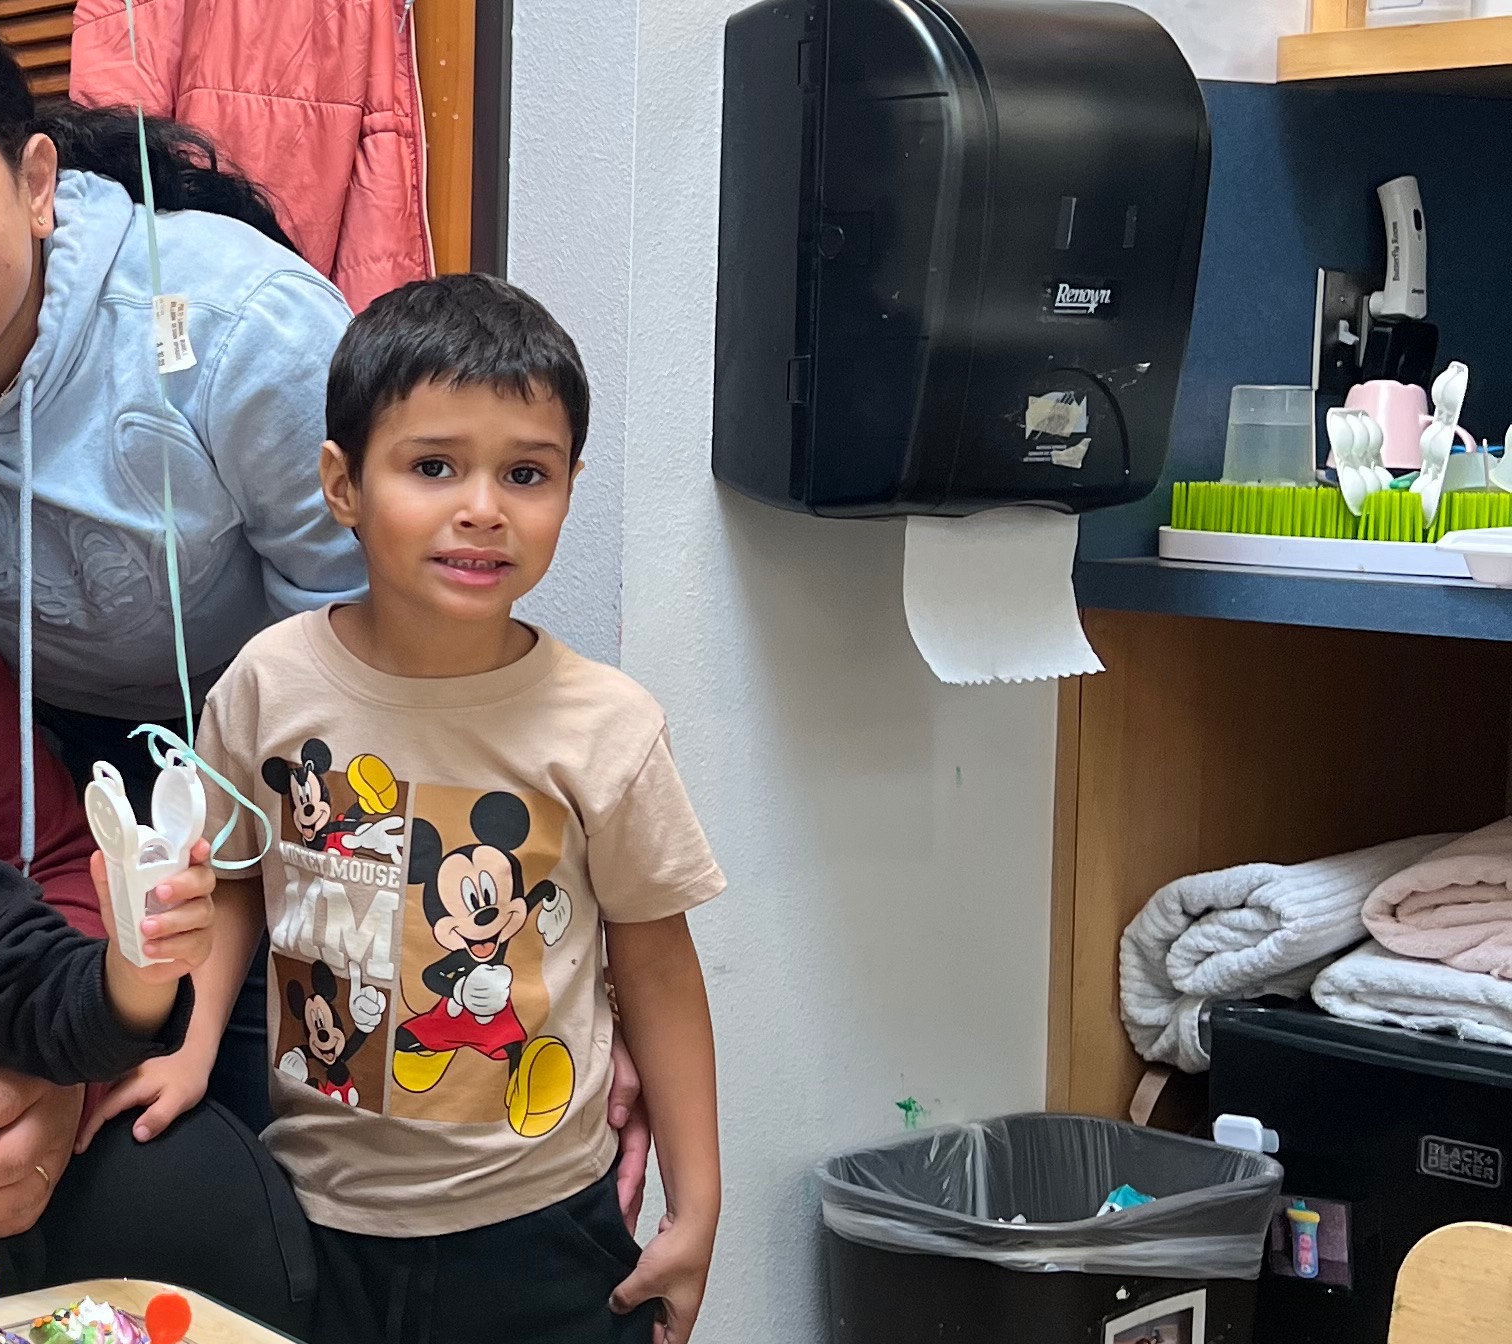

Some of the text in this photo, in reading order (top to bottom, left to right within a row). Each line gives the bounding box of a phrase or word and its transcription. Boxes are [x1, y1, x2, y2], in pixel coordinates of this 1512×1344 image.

[1056, 283, 1111, 304] Renown
[329, 856, 402, 889] MOUSE
[1428, 1156, 1494, 1182] DECKER
